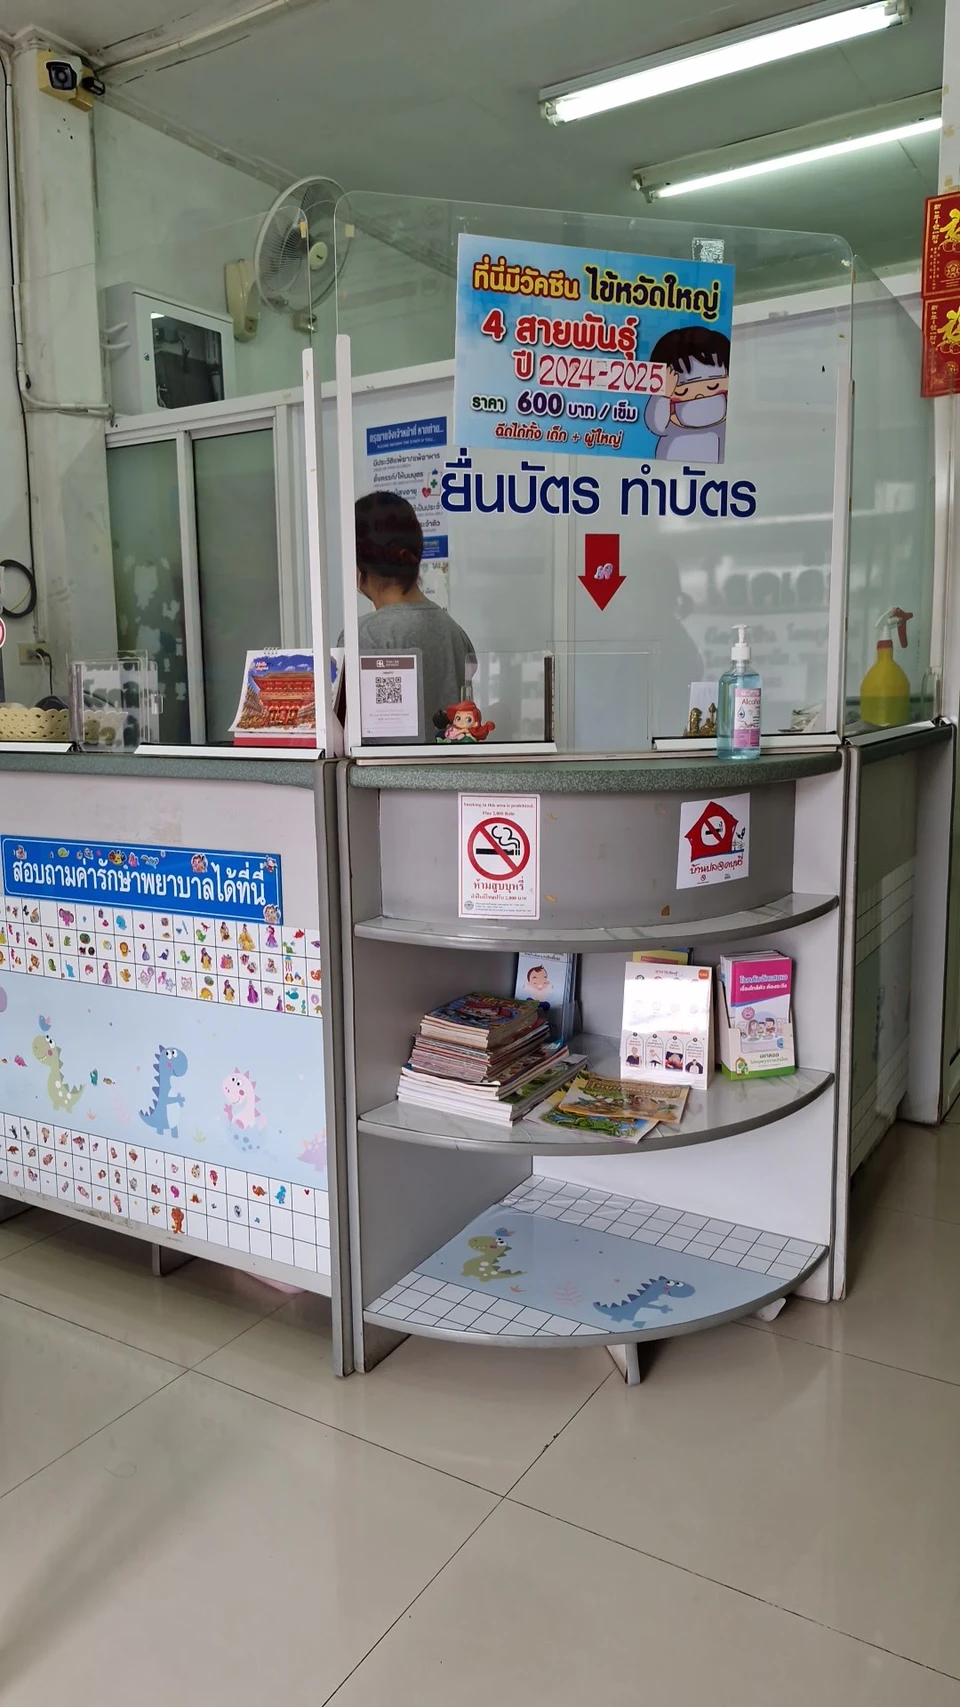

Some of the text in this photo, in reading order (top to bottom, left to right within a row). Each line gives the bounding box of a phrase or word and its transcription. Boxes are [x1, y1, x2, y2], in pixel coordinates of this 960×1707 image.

[473, 254, 721, 322] ที่นี่มีวัคซีน ไข้หวัดใหญ่
[481, 309, 640, 359] 4 สายพันธุ์
[512, 348, 664, 393] ปี 2024-2025
[471, 396, 507, 412] ราคา
[517, 391, 564, 417] 600
[568, 402, 595, 418] บาท
[613, 400, 637, 421] เข็ม
[495, 422, 541, 441] ฉีดได้ทั้ง
[546, 424, 567, 442] เด็ก
[584, 427, 623, 449] ผู้ใหญ่
[441, 446, 757, 518] ยื่นบัตร ทำบัตร
[12, 858, 268, 906] สอบถามค่ารักษาพยาบาลได้ที่นี่
[473, 876, 524, 893] ห้ามสูบบุหรี่
